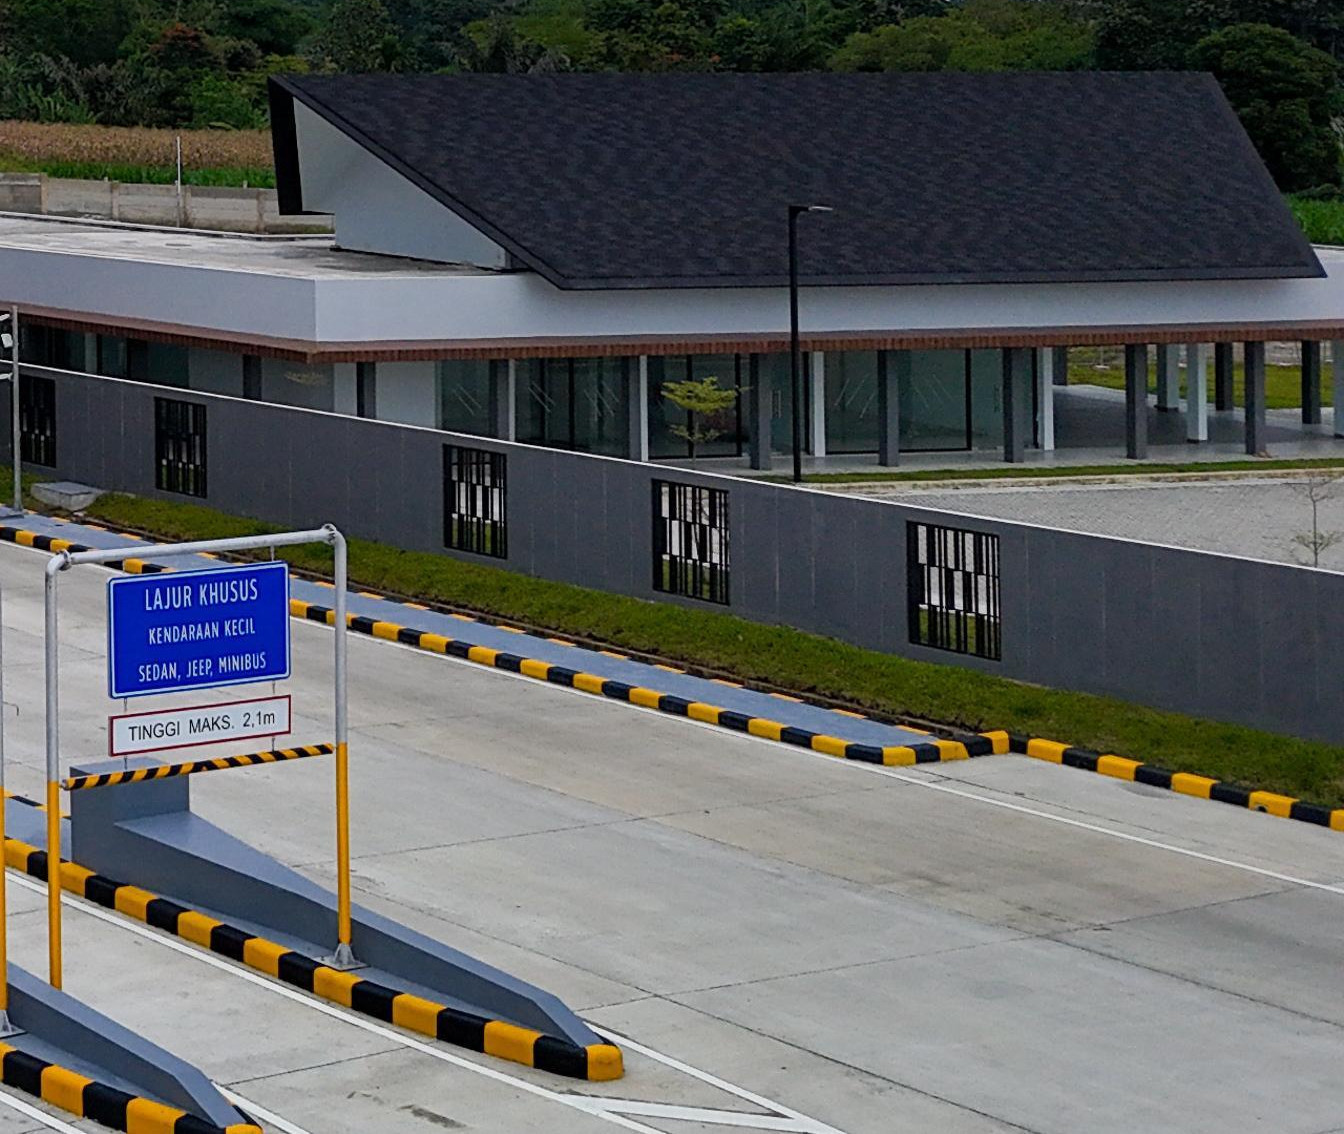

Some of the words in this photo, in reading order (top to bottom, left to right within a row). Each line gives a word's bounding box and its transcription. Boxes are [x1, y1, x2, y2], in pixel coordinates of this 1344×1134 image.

[144, 584, 193, 612] LAJUR
[199, 577, 259, 606] KHUSUS
[148, 621, 220, 646] KENDARAAN
[224, 617, 256, 638] KECIL
[138, 661, 182, 683] SEDAN,
[186, 657, 213, 678] JEEP,
[218, 651, 267, 674] MINIBUS
[128, 720, 181, 742] TINGGI
[188, 714, 235, 736] MAKS.
[242, 710, 276, 729] 2,1m
